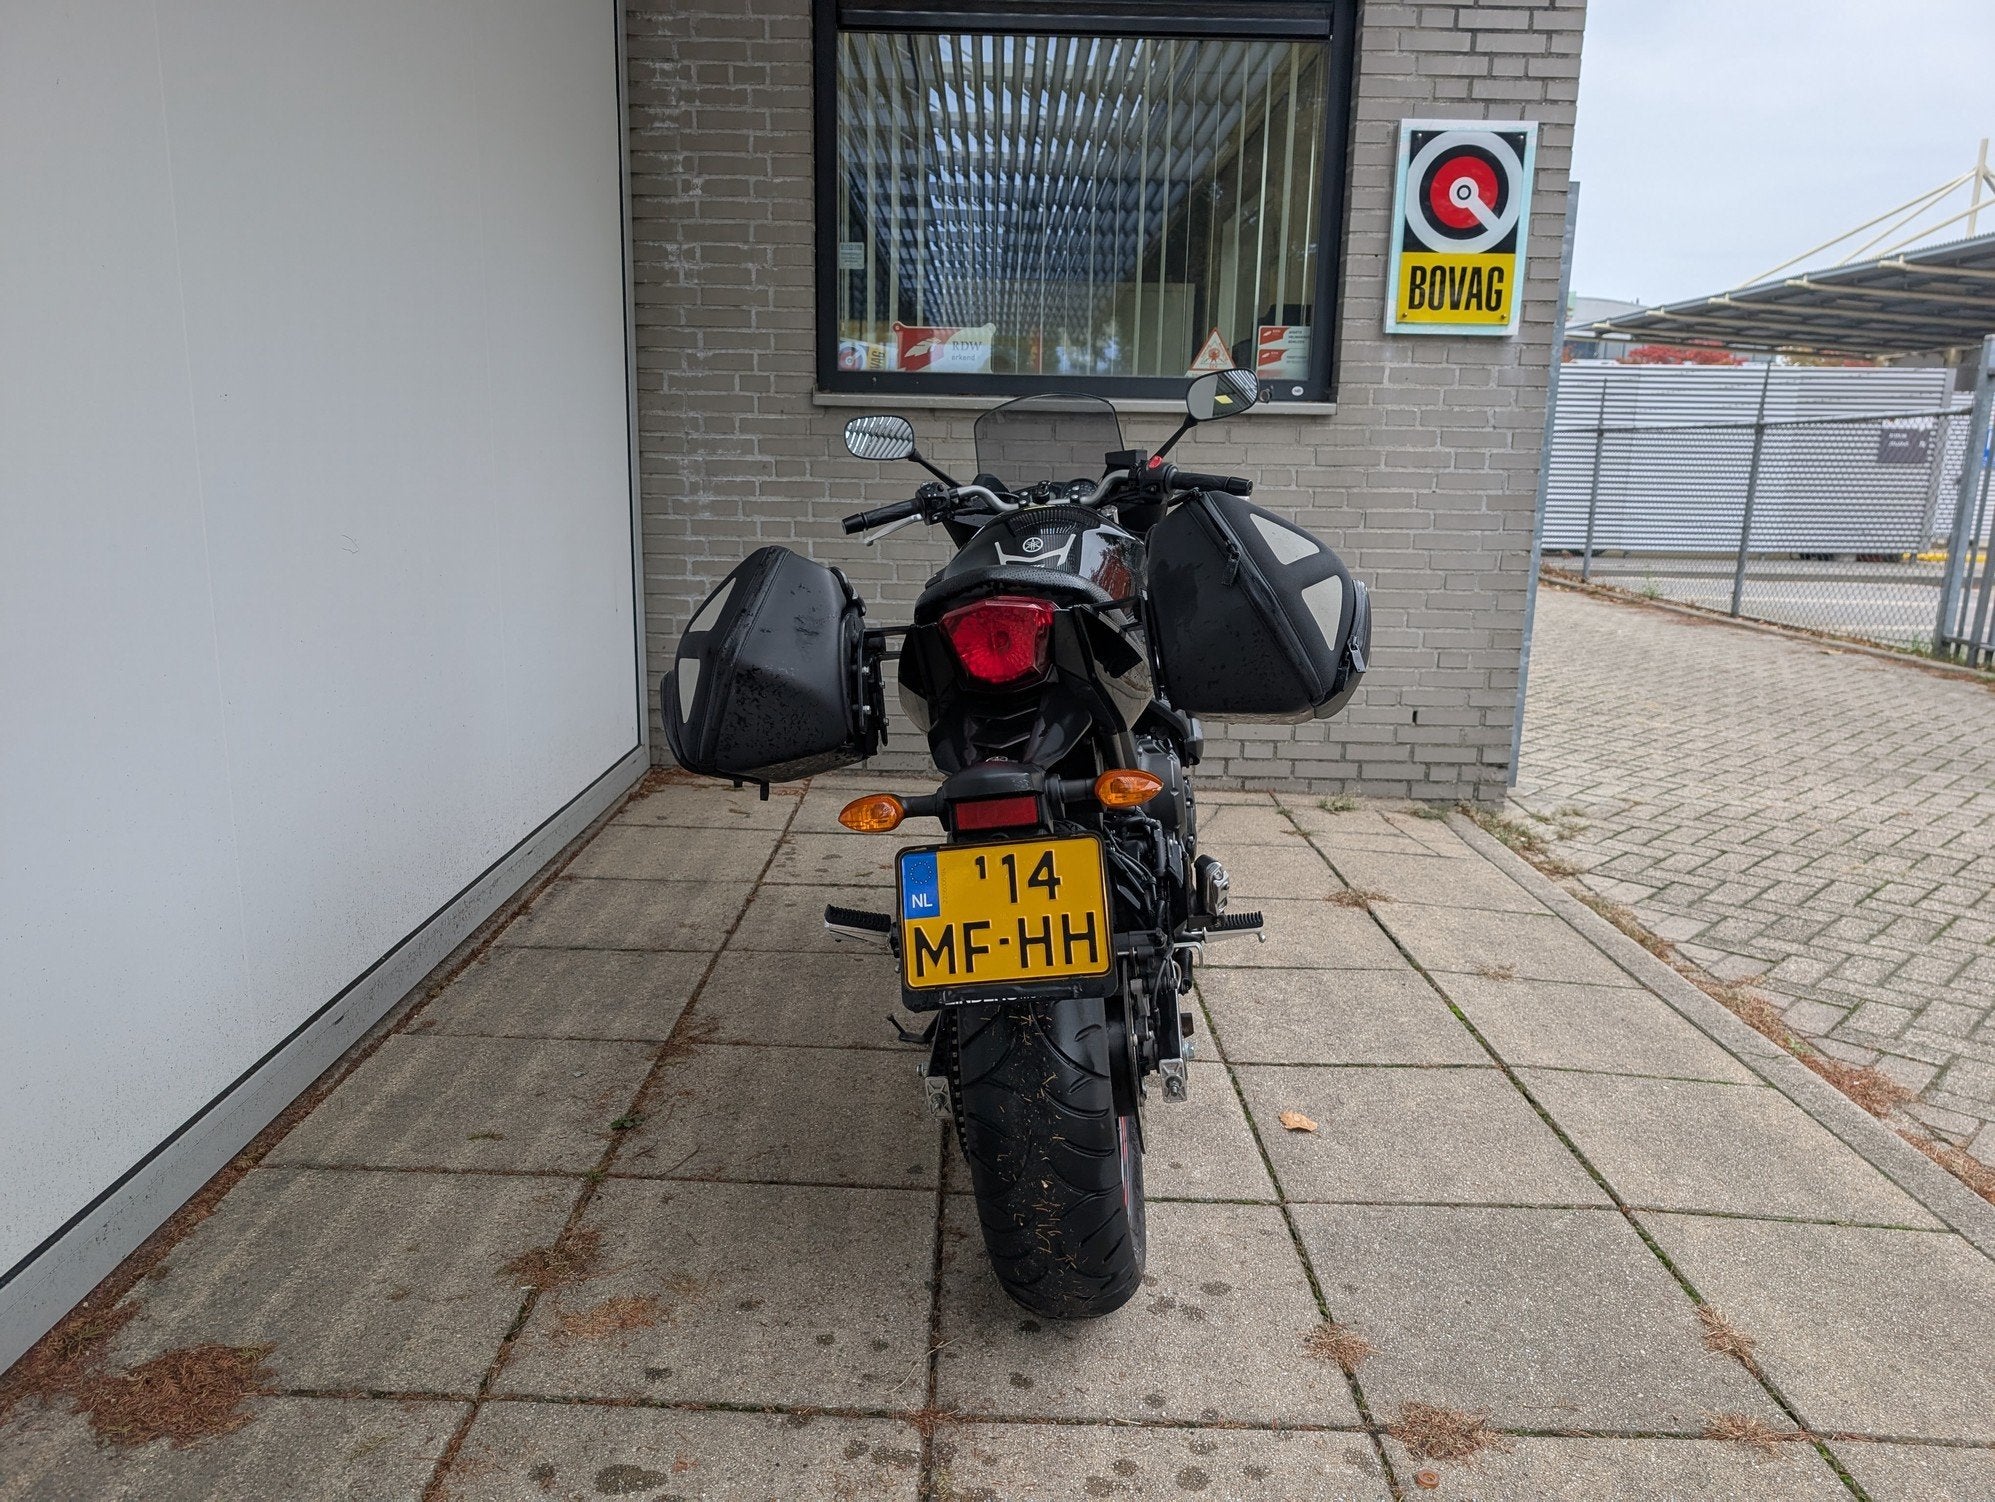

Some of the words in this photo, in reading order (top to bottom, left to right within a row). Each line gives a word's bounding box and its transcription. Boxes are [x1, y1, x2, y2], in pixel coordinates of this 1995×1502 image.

[1408, 265, 1505, 312] BOVAG
[952, 341, 982, 351] RDW
[912, 893, 933, 909] NL
[913, 911, 1099, 978] MF-HH
